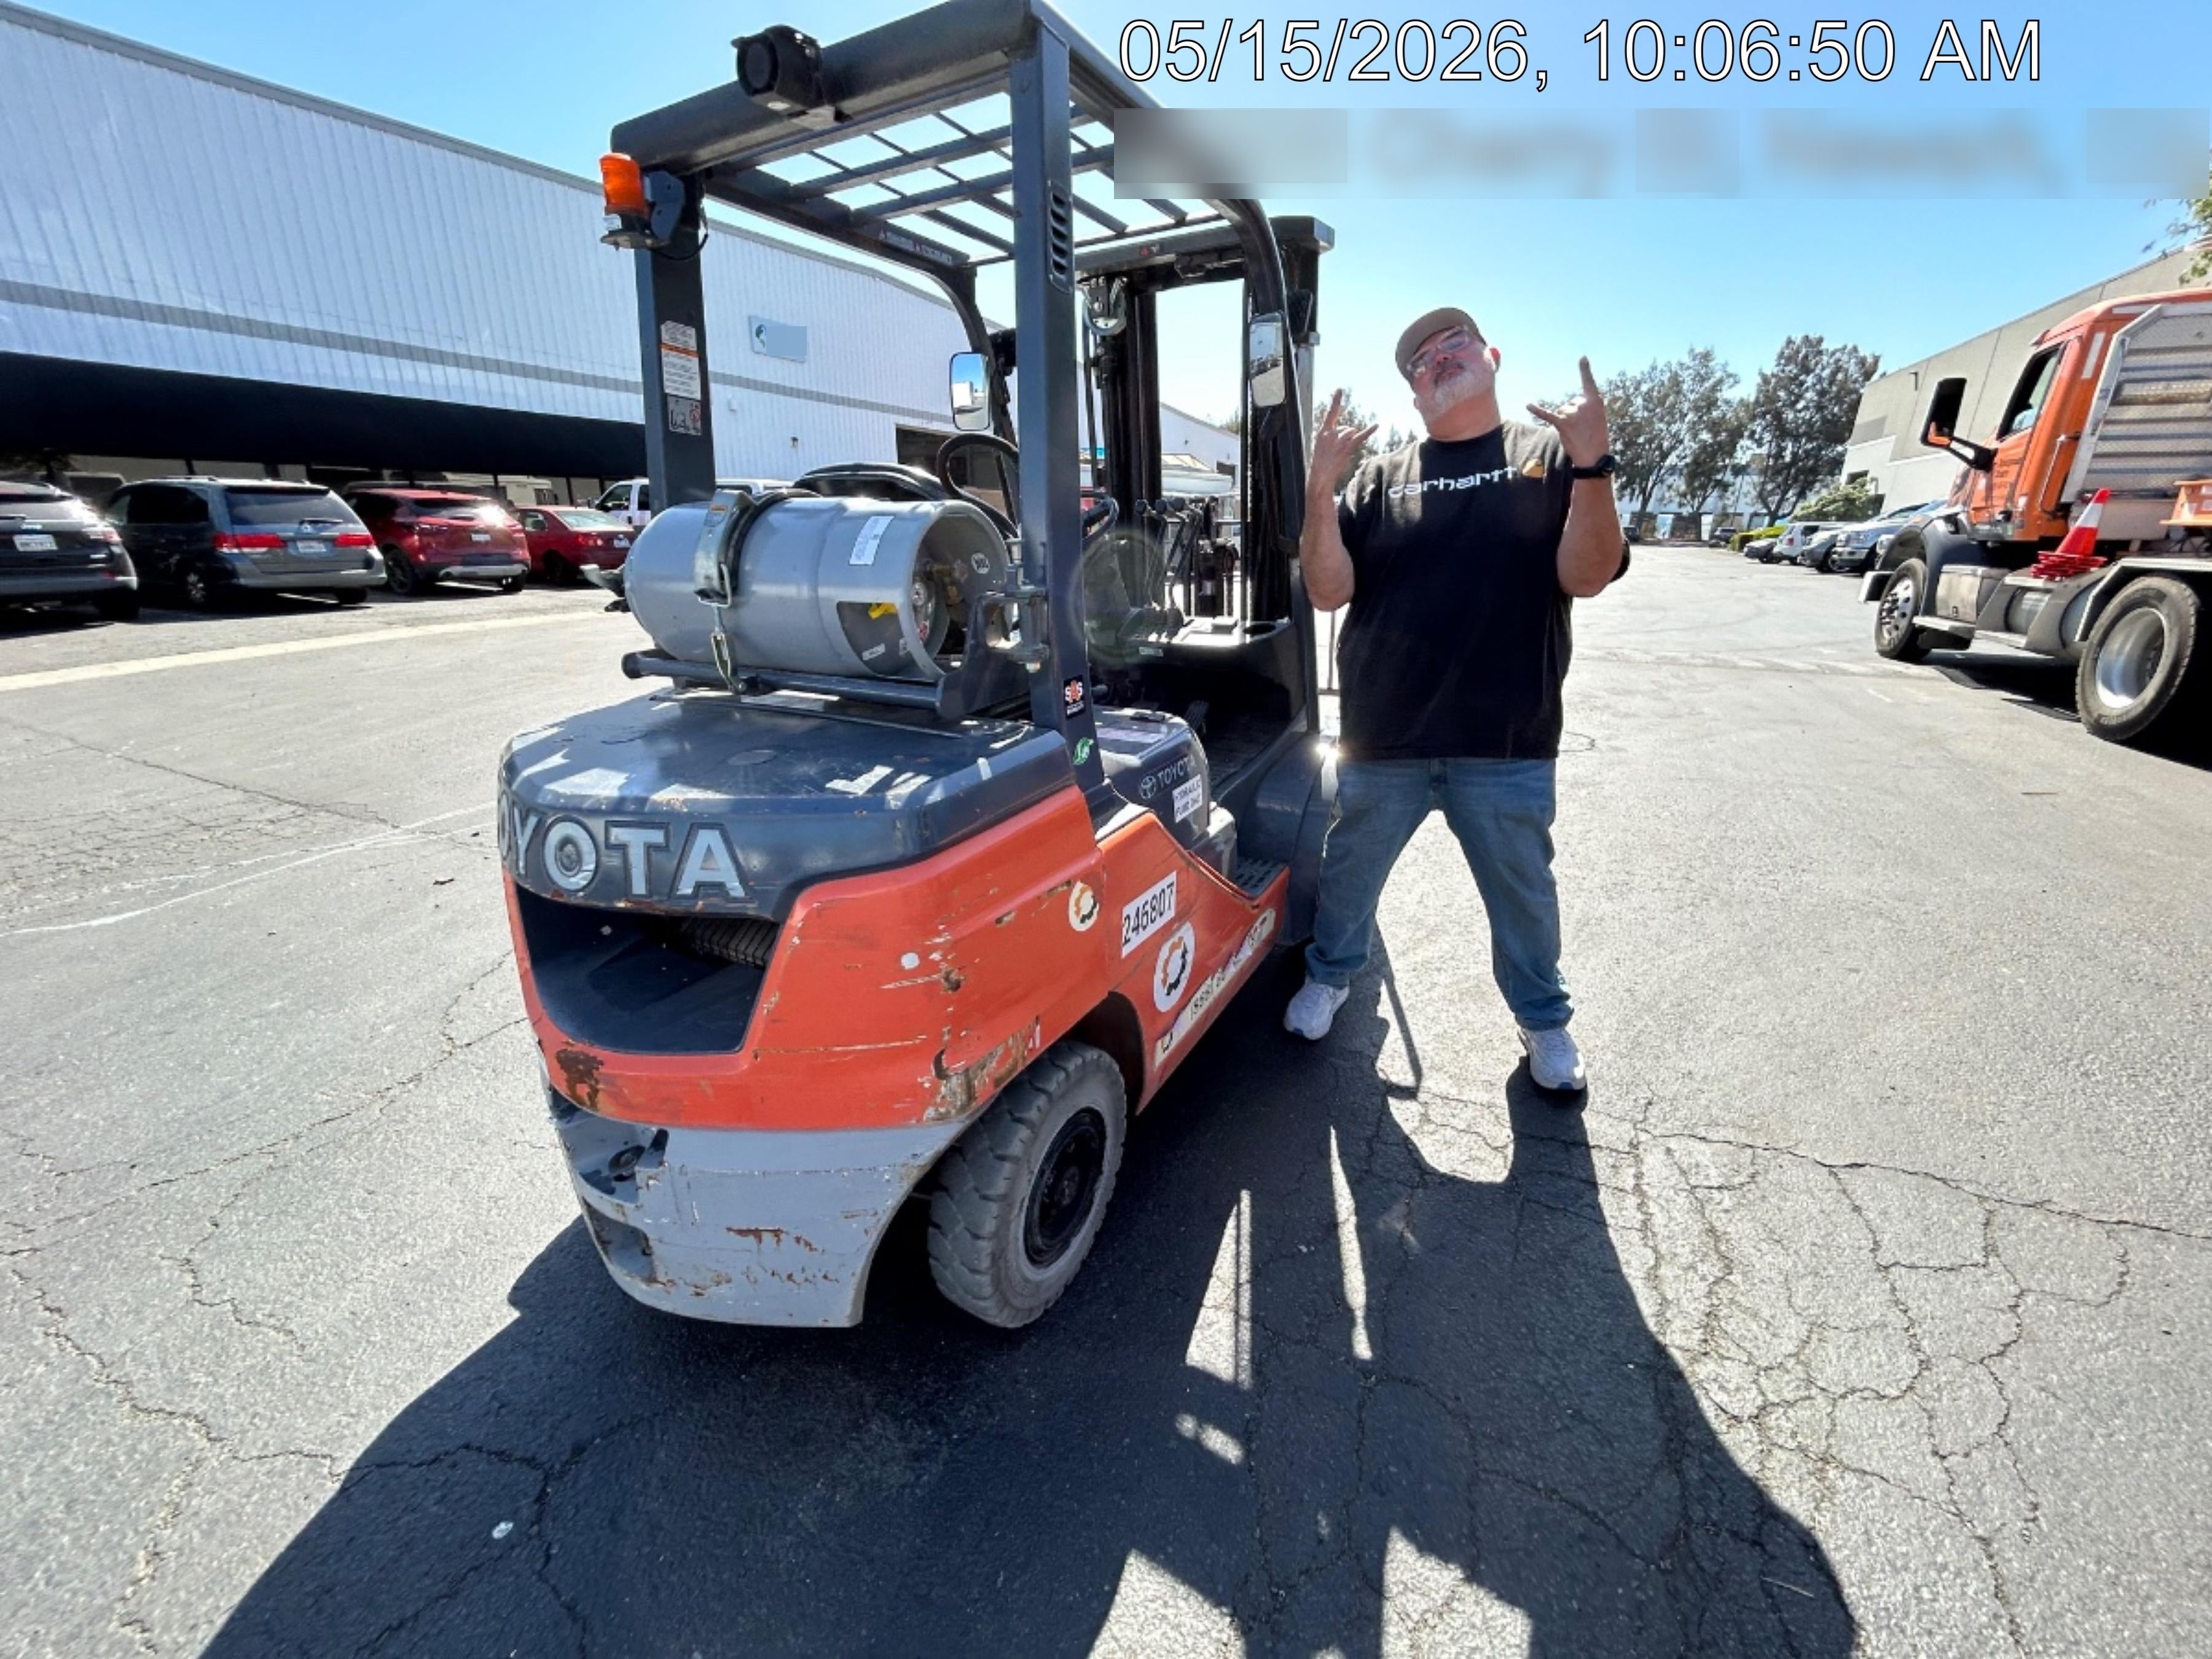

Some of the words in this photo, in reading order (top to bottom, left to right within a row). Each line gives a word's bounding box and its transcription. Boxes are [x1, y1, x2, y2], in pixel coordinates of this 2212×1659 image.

[1387, 465, 1518, 499] carhartt
[498, 791, 747, 898] OYOTA
[1123, 880, 1175, 946] 246807
